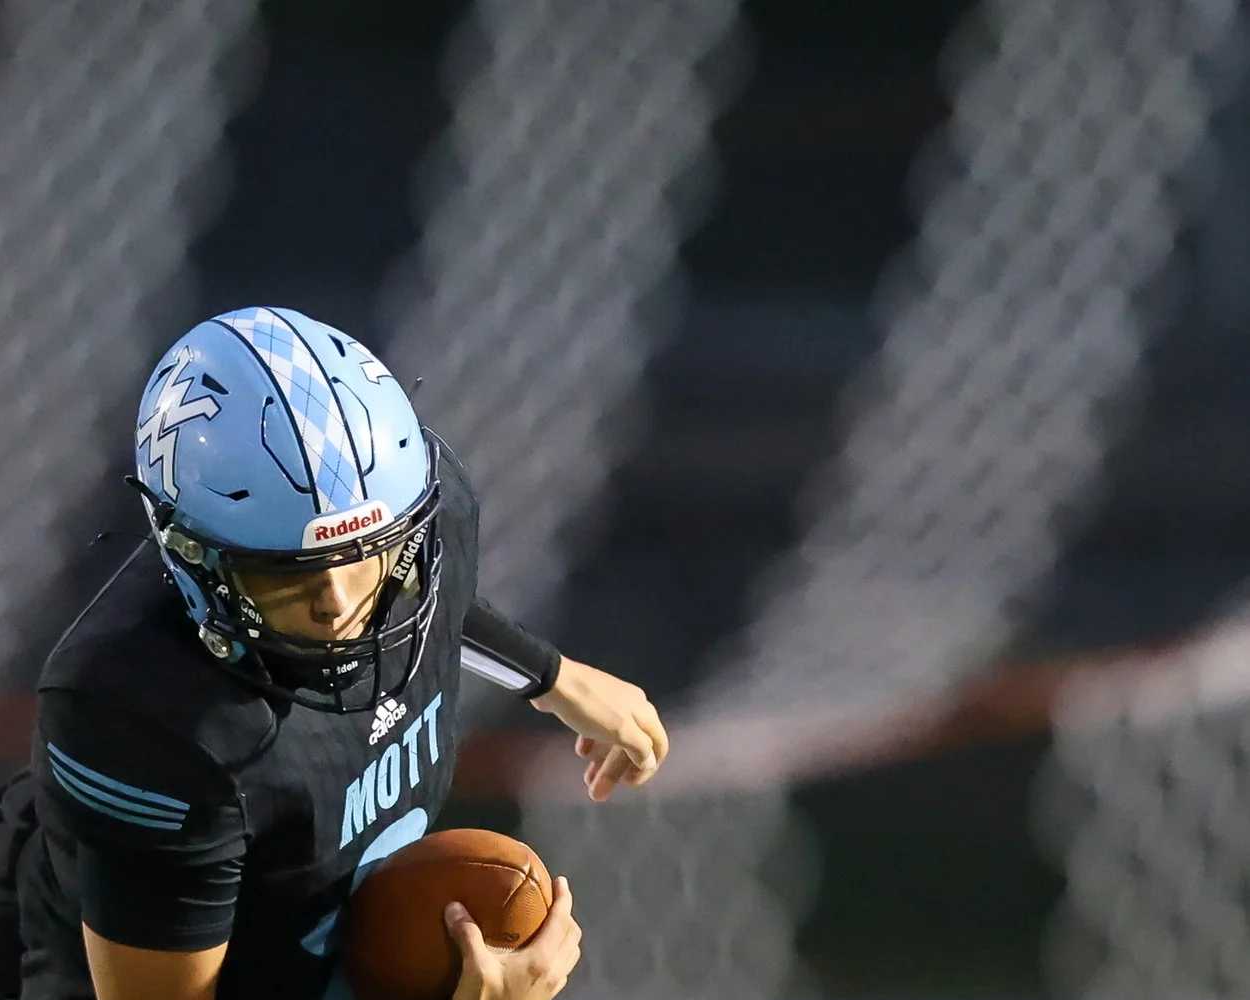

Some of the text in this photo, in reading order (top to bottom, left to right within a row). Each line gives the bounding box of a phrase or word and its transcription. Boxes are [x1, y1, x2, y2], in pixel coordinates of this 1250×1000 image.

[315, 507, 383, 541] Riddell
[391, 523, 429, 581] Ridde
[369, 702, 407, 746] adidas
[339, 691, 442, 850] MOTT
